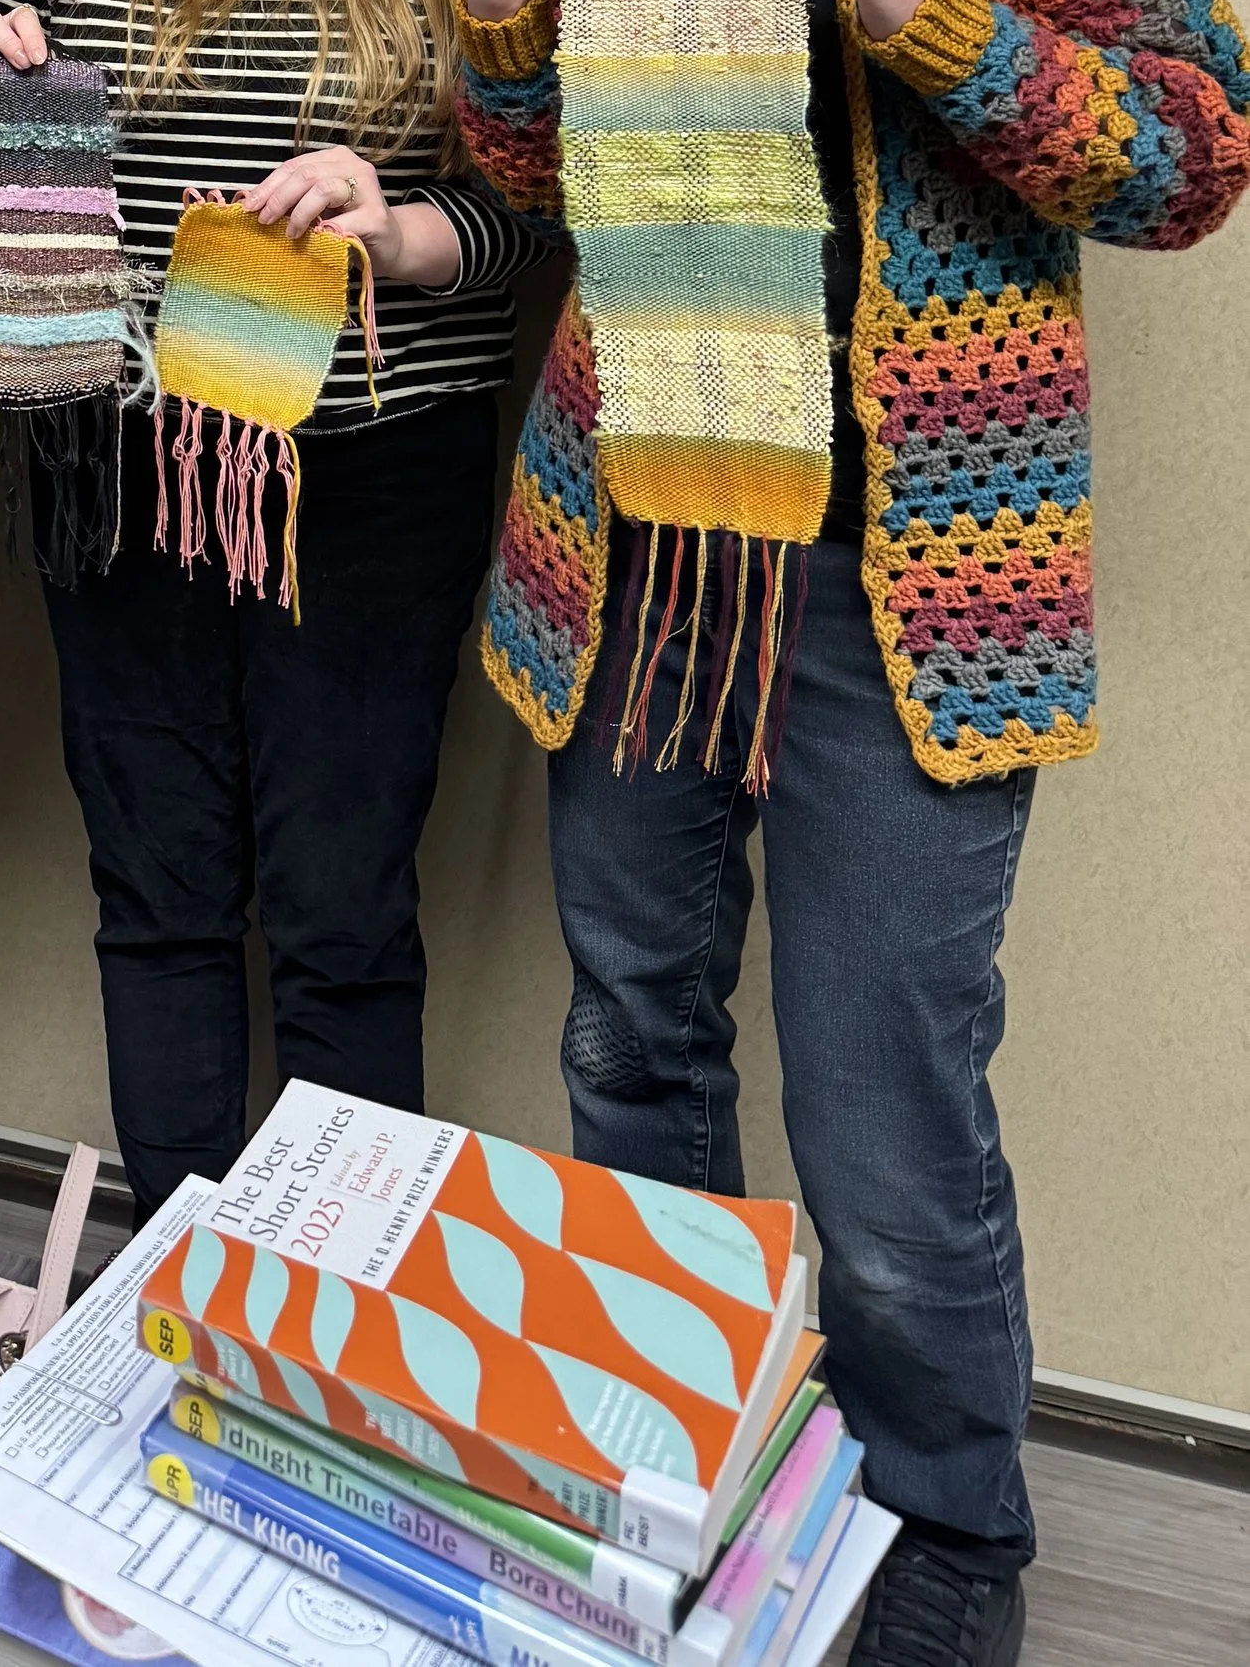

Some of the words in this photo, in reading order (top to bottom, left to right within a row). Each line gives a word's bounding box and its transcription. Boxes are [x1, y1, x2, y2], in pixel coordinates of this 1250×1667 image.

[330, 1159, 353, 1187] Edited
[347, 1150, 362, 1164] by
[347, 1143, 387, 1195] Edward
[380, 1132, 396, 1147] P.
[421, 1128, 455, 1175] WINNERS
[211, 1183, 262, 1225] The
[243, 1137, 294, 1182] Best
[250, 1180, 308, 1242] Short
[291, 1106, 355, 1178] Stories
[371, 1167, 403, 1203] Jones
[403, 1176, 428, 1210] PRIZE
[291, 1197, 344, 1257] 2025
[382, 1209, 408, 1243] HENRY
[376, 1245, 392, 1256] O.
[362, 1263, 385, 1279] THE
[12, 1369, 45, 1400] PASSPORT
[64, 1310, 103, 1347] APPLICATION
[107, 1273, 134, 1299] ELIGIBLE
[59, 1310, 88, 1337] Department
[160, 1318, 174, 1356] SEP
[24, 1412, 51, 1437] Passport
[83, 1351, 110, 1376] Passport
[189, 1401, 203, 1440] SEP
[221, 1417, 313, 1484] idnight
[321, 1466, 458, 1554] Timetable
[489, 1548, 548, 1598] Bora
[254, 1511, 340, 1579] KHONG
[638, 1514, 649, 1548] BEST
